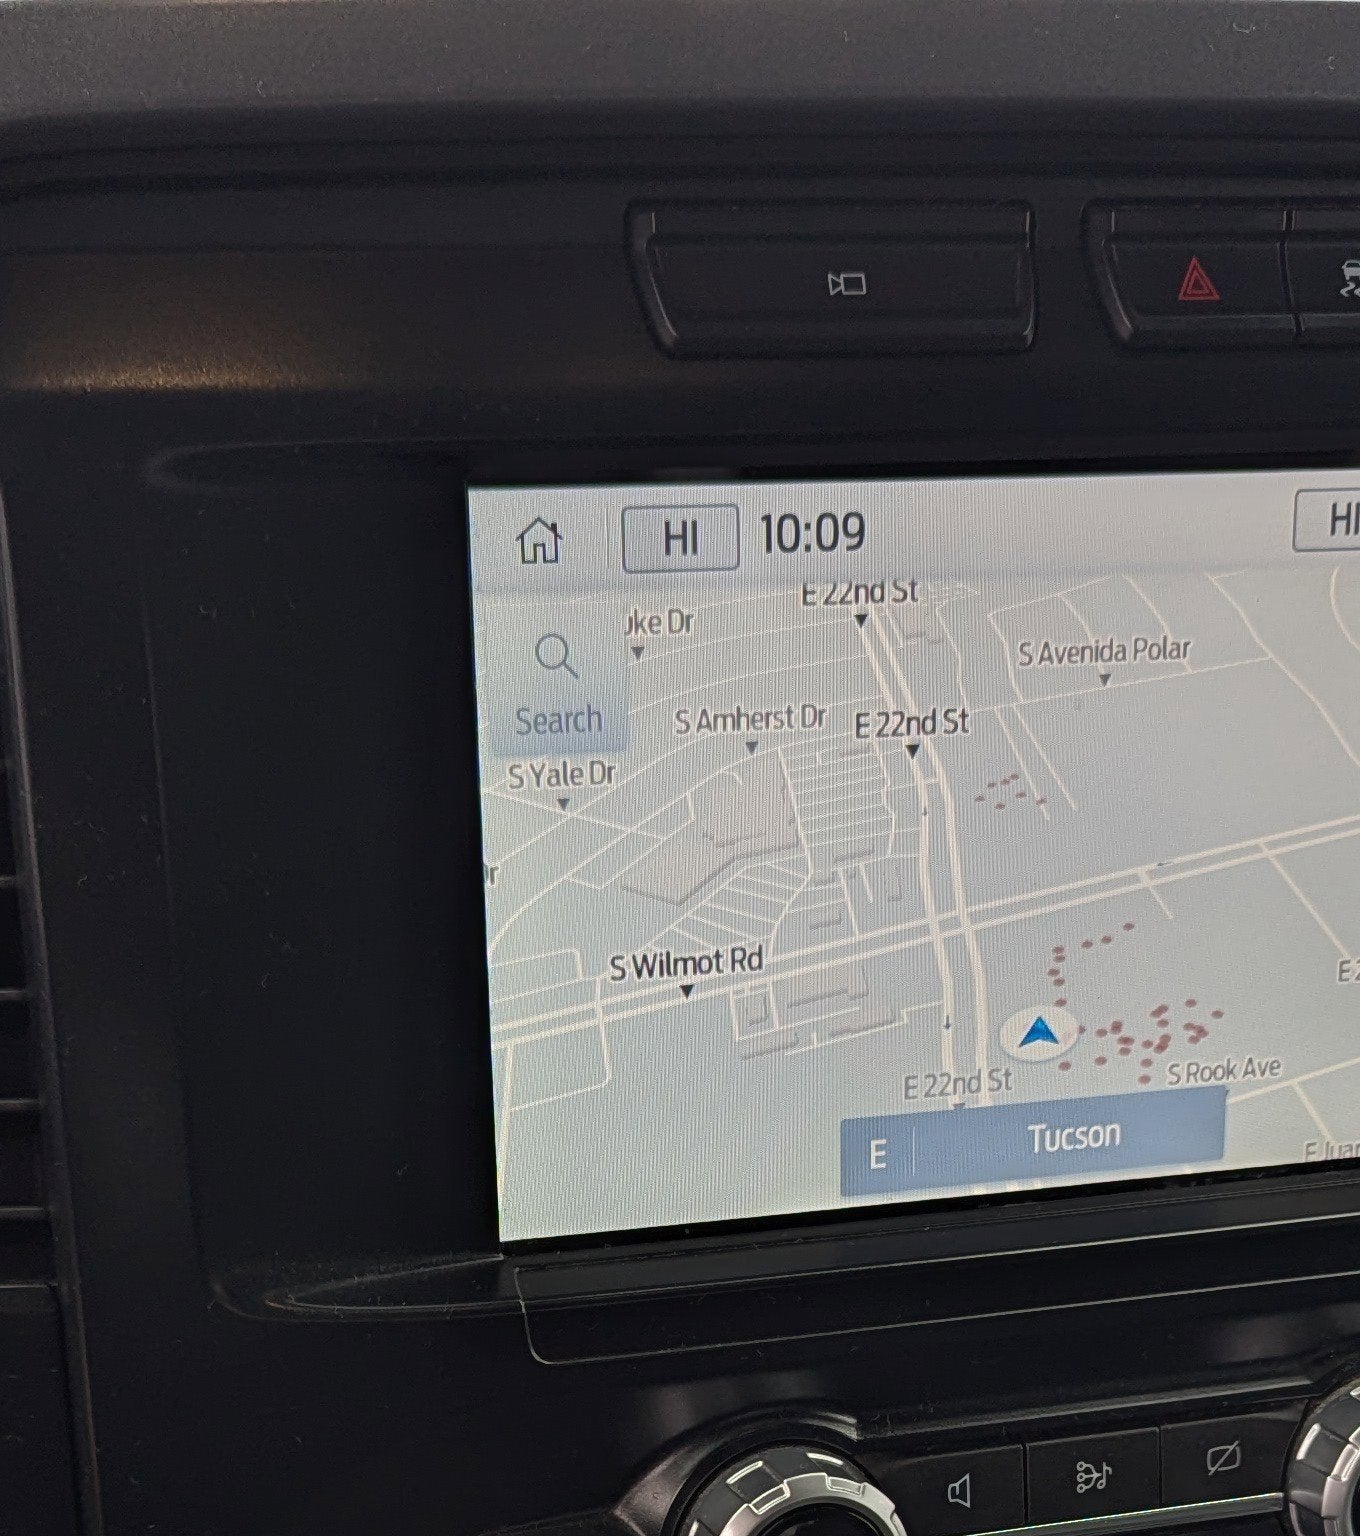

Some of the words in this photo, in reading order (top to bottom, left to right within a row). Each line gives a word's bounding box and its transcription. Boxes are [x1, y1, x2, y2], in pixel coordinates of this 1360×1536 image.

[664, 519, 699, 556] HI
[761, 511, 867, 554] 10:09
[802, 582, 817, 606] E
[823, 580, 886, 606] 22nd
[891, 578, 919, 603] St
[667, 608, 695, 635] Dr
[1019, 642, 1033, 667] S
[1039, 637, 1128, 665] Avenida
[1133, 636, 1192, 661] Polar
[515, 702, 603, 736] Search
[675, 710, 690, 735] S
[695, 704, 796, 734] Amherst
[800, 704, 828, 729] Dr
[855, 712, 871, 739] E
[876, 706, 938, 738] 22nd
[943, 707, 971, 734] St
[508, 764, 525, 789] S
[528, 761, 585, 788] Yale
[589, 762, 617, 786] Dr
[610, 955, 627, 981] S
[632, 948, 726, 981] Wilmot
[731, 944, 764, 973] Rd
[1338, 959, 1351, 983] E
[904, 1074, 918, 1101] E
[924, 1069, 982, 1099] 22nd
[988, 1068, 1013, 1093] St
[1168, 1062, 1181, 1086] S
[1185, 1057, 1238, 1083] Rook
[1242, 1056, 1282, 1080] Ave
[869, 1138, 888, 1170] E
[1028, 1122, 1122, 1155] Tucson
